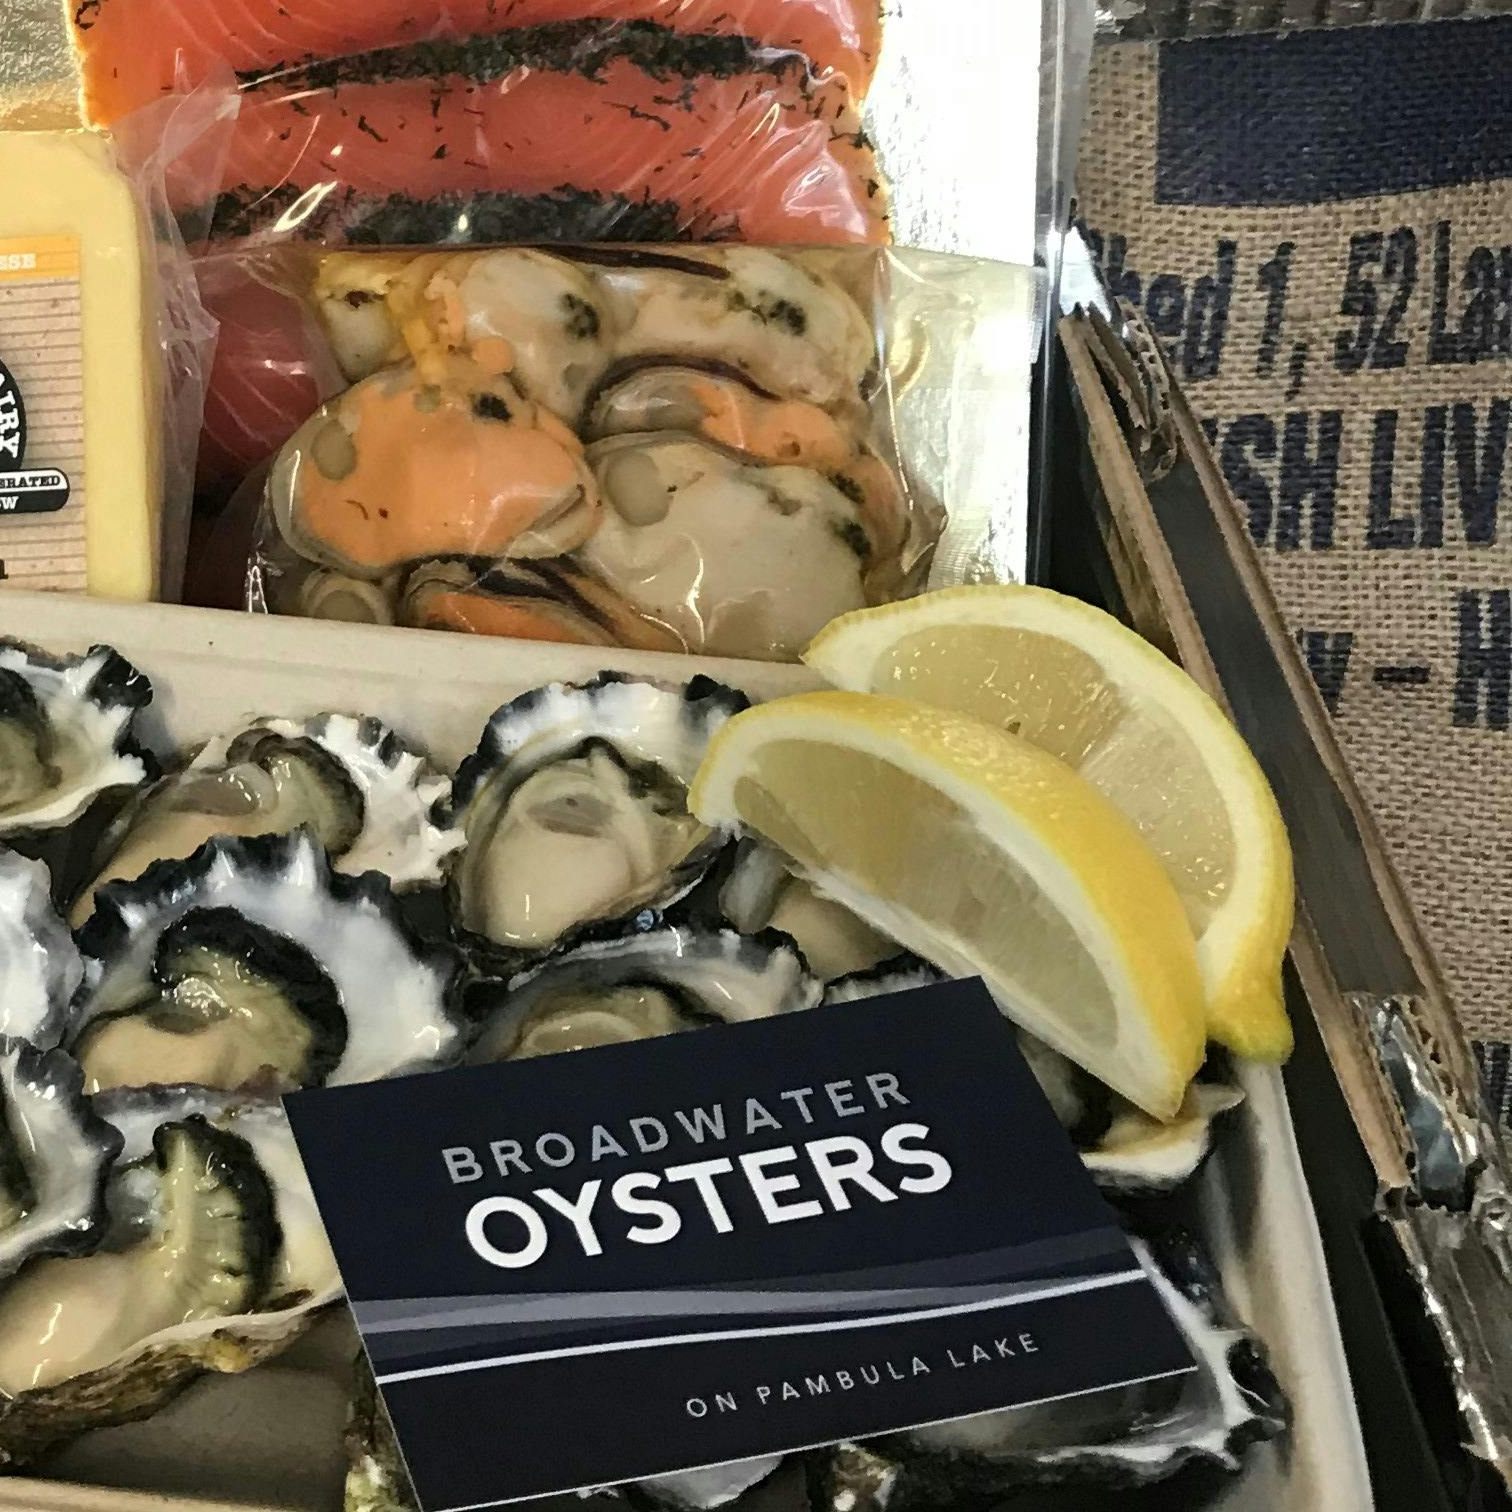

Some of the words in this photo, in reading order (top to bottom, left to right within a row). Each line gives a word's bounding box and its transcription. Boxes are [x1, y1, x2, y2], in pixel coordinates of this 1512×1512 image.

[1334, 224, 1420, 374] 52
[1364, 397, 1512, 550] LIV
[441, 1070, 912, 1186] BROADWATER
[463, 1121, 955, 1270] OYSTERS
[686, 1390, 740, 1419] ON
[757, 1355, 933, 1408] PAMBULA
[948, 1330, 1042, 1369] LAKE
